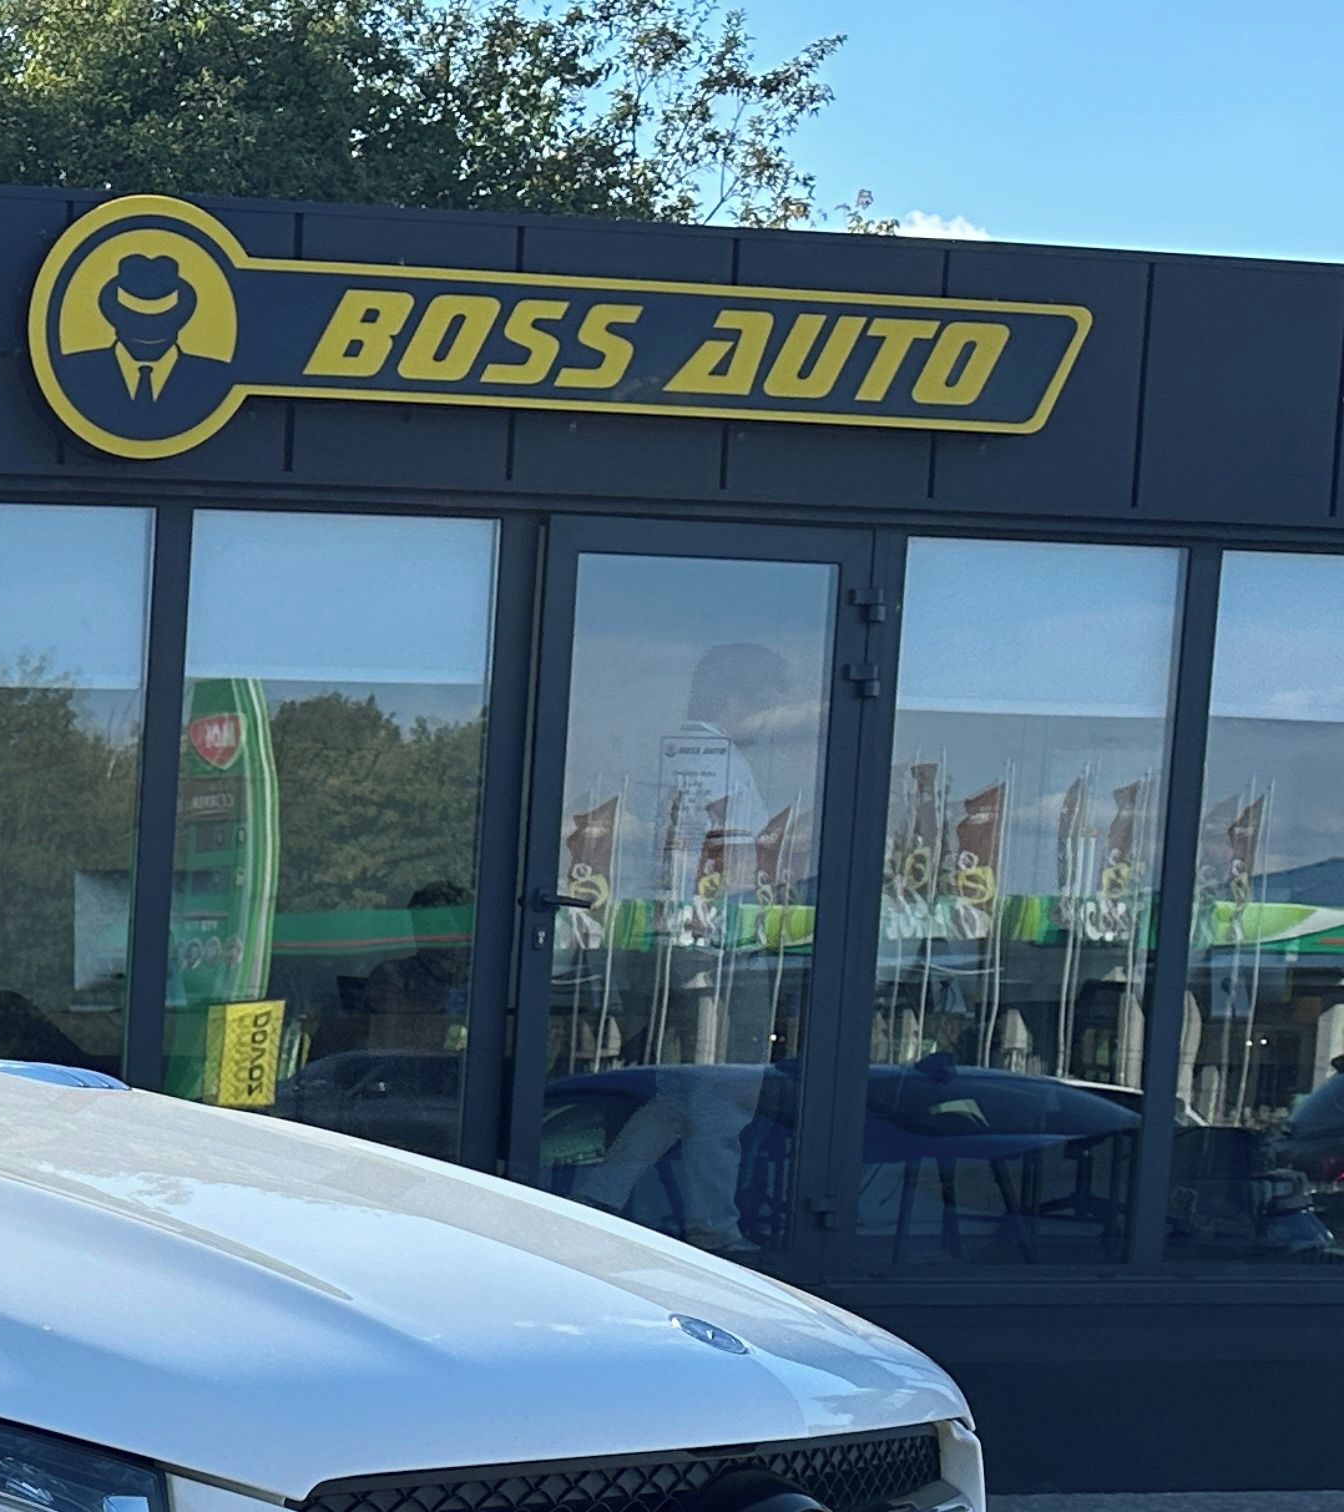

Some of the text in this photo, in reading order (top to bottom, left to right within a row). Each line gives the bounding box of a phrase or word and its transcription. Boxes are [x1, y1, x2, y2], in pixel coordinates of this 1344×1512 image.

[303, 287, 1012, 407] BOSS AUTO
[245, 1009, 273, 1099] DOVOZ
